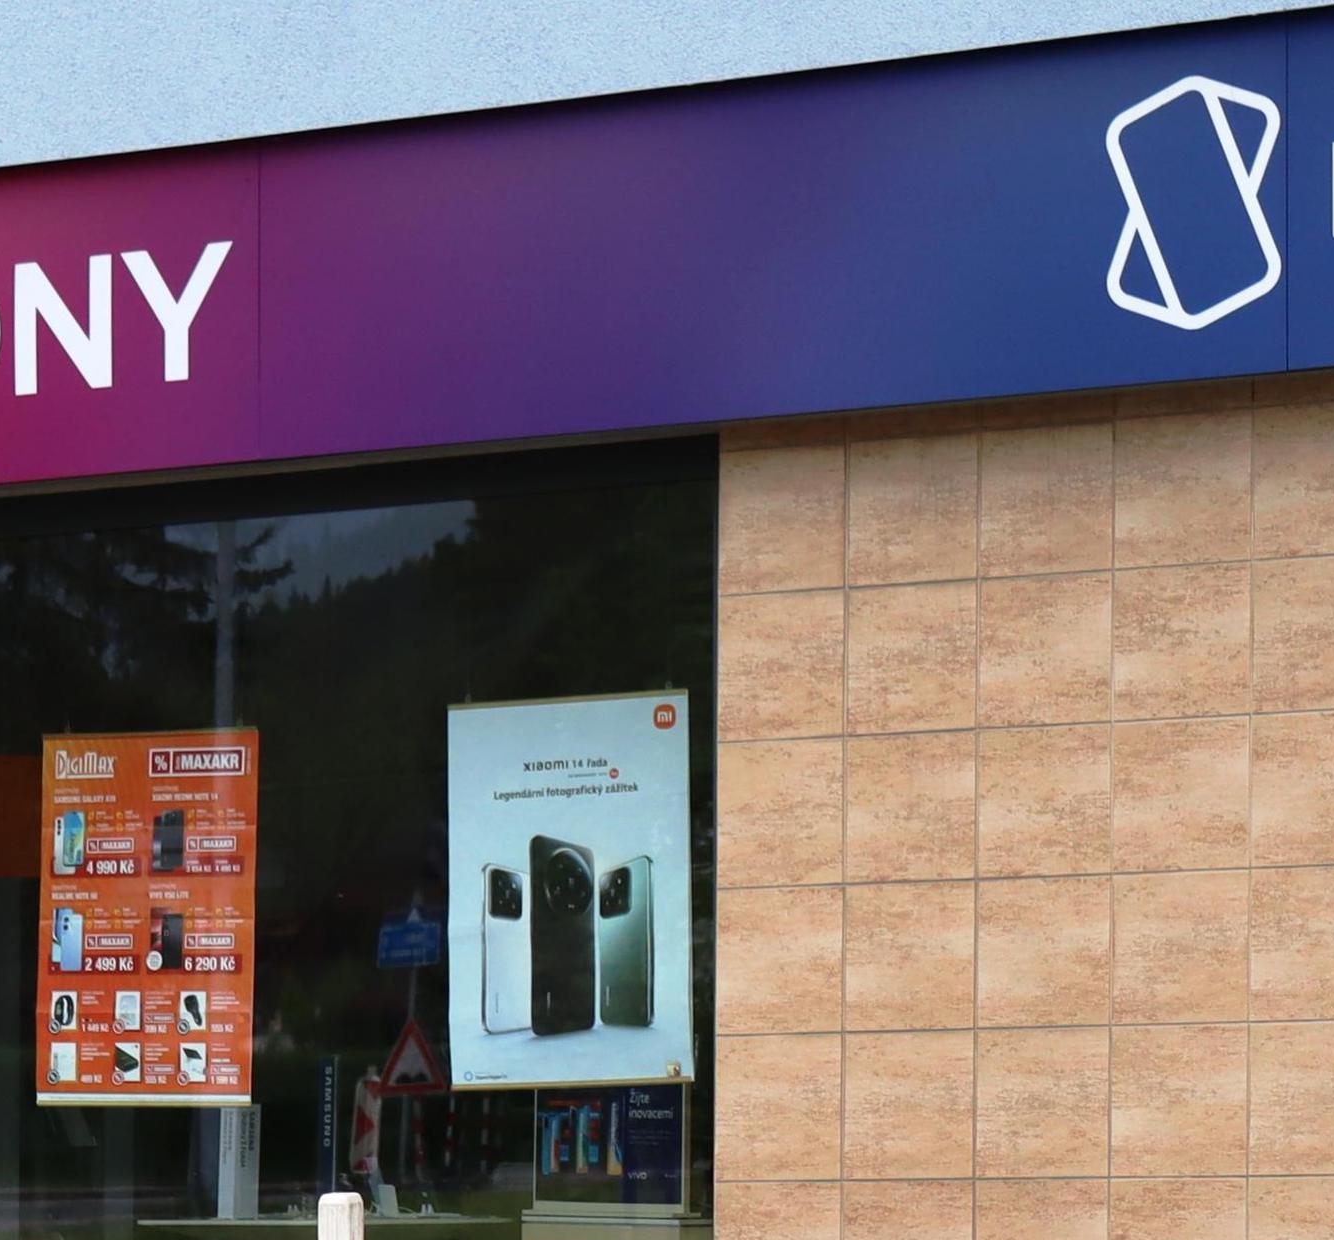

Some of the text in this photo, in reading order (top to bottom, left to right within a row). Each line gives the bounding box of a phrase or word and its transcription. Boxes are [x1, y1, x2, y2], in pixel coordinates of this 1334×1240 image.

[180, 752, 239, 770] MAXAKR
[572, 759, 584, 769] 14
[586, 757, 608, 768] řada
[493, 782, 639, 802] Legendární fotografický zážitek
